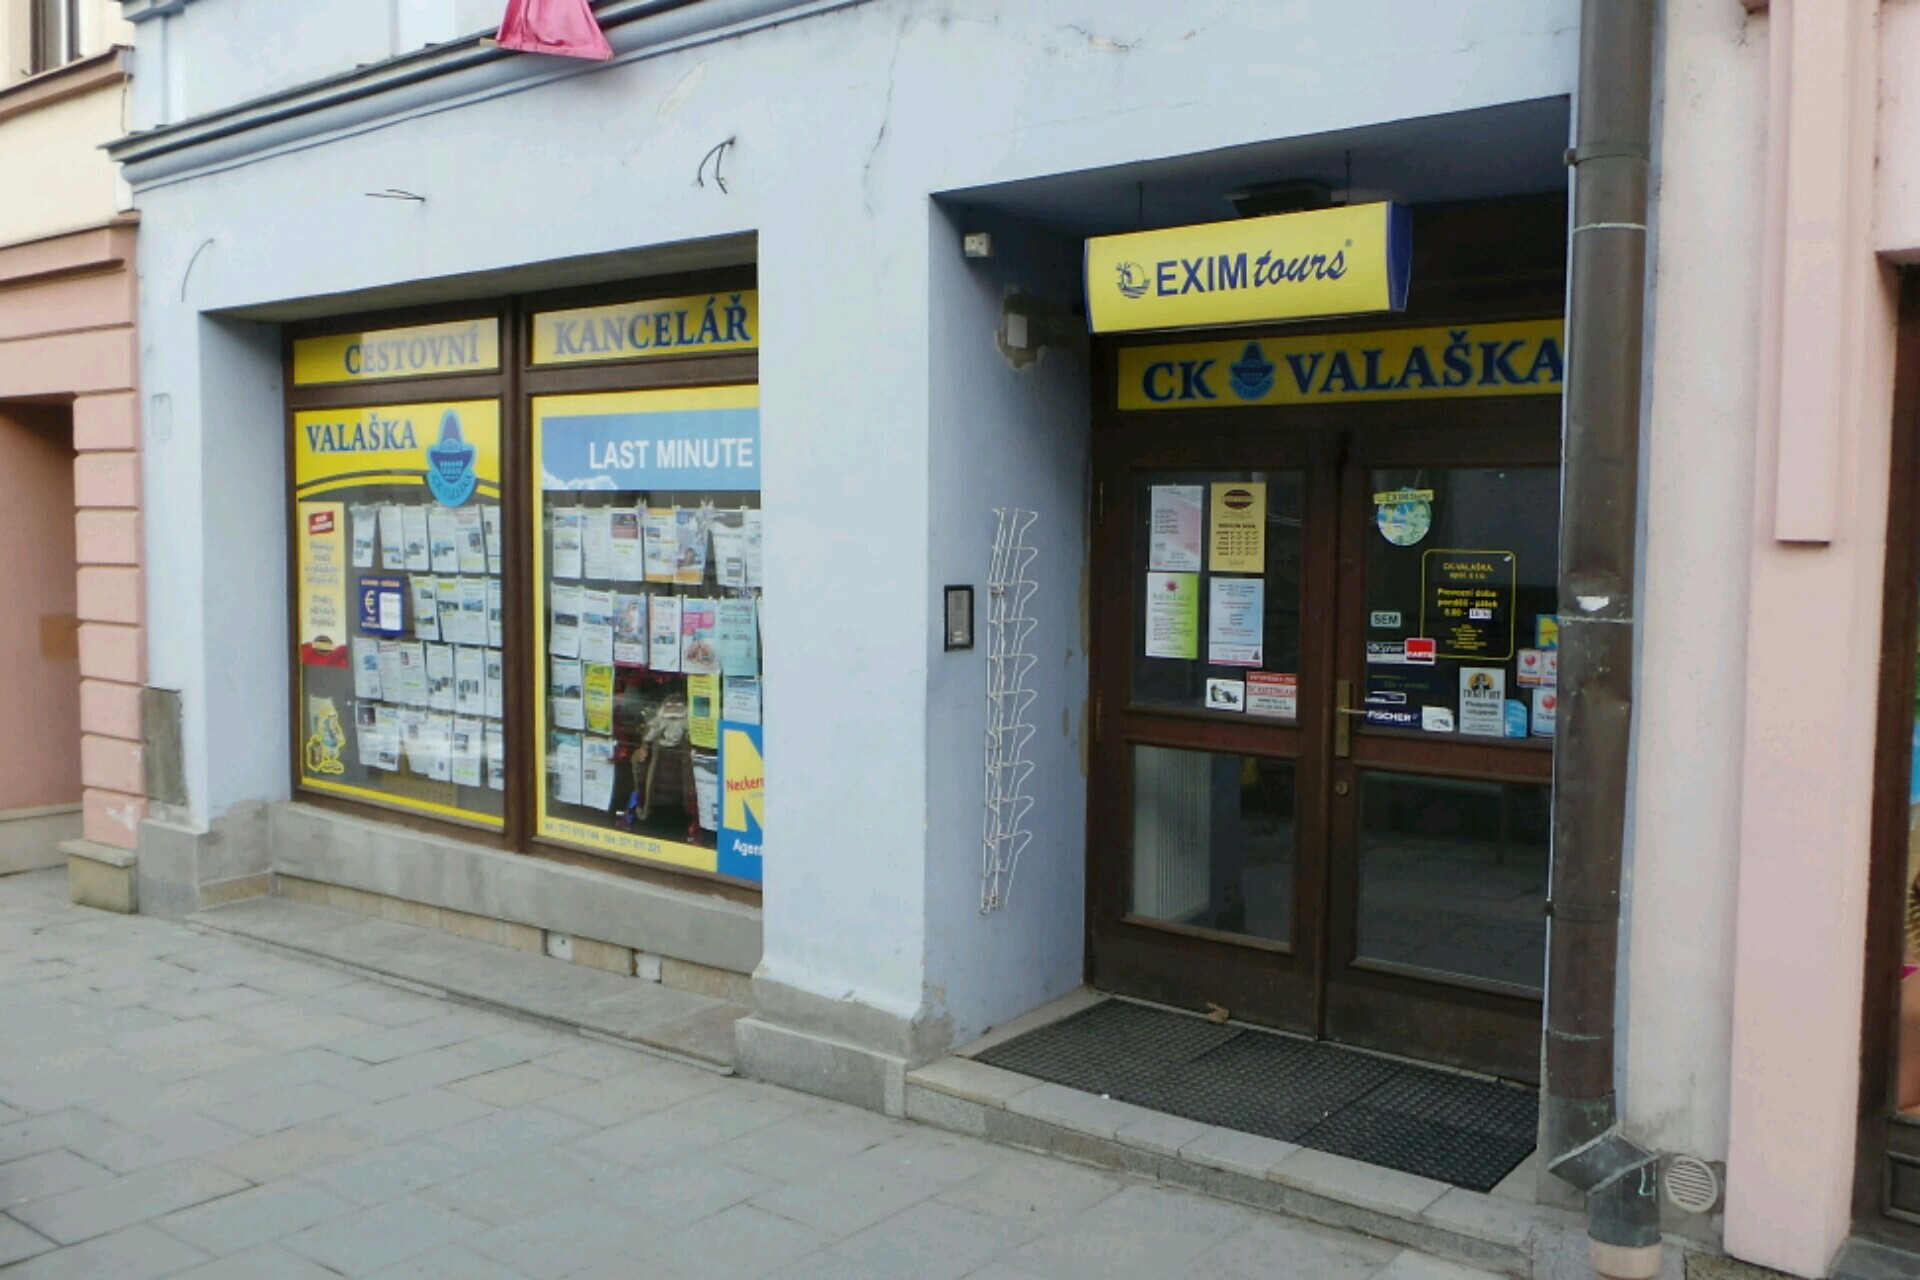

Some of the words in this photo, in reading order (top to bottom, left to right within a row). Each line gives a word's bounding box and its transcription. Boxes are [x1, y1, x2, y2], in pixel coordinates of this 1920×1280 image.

[1156, 253, 1248, 297] EXIM
[1252, 249, 1349, 286] tours
[554, 294, 752, 355] KANCELÁŘ
[344, 324, 480, 374] CESTOVNÍ
[1142, 359, 1218, 401] CK
[1286, 329, 1562, 394] VALAŠKA
[306, 413, 418, 453] VALAŠKA
[589, 440, 649, 470] LAST
[657, 438, 753, 468] MINUTE
[1374, 614, 1399, 625] SEM
[1367, 710, 1412, 722] FISCHER
